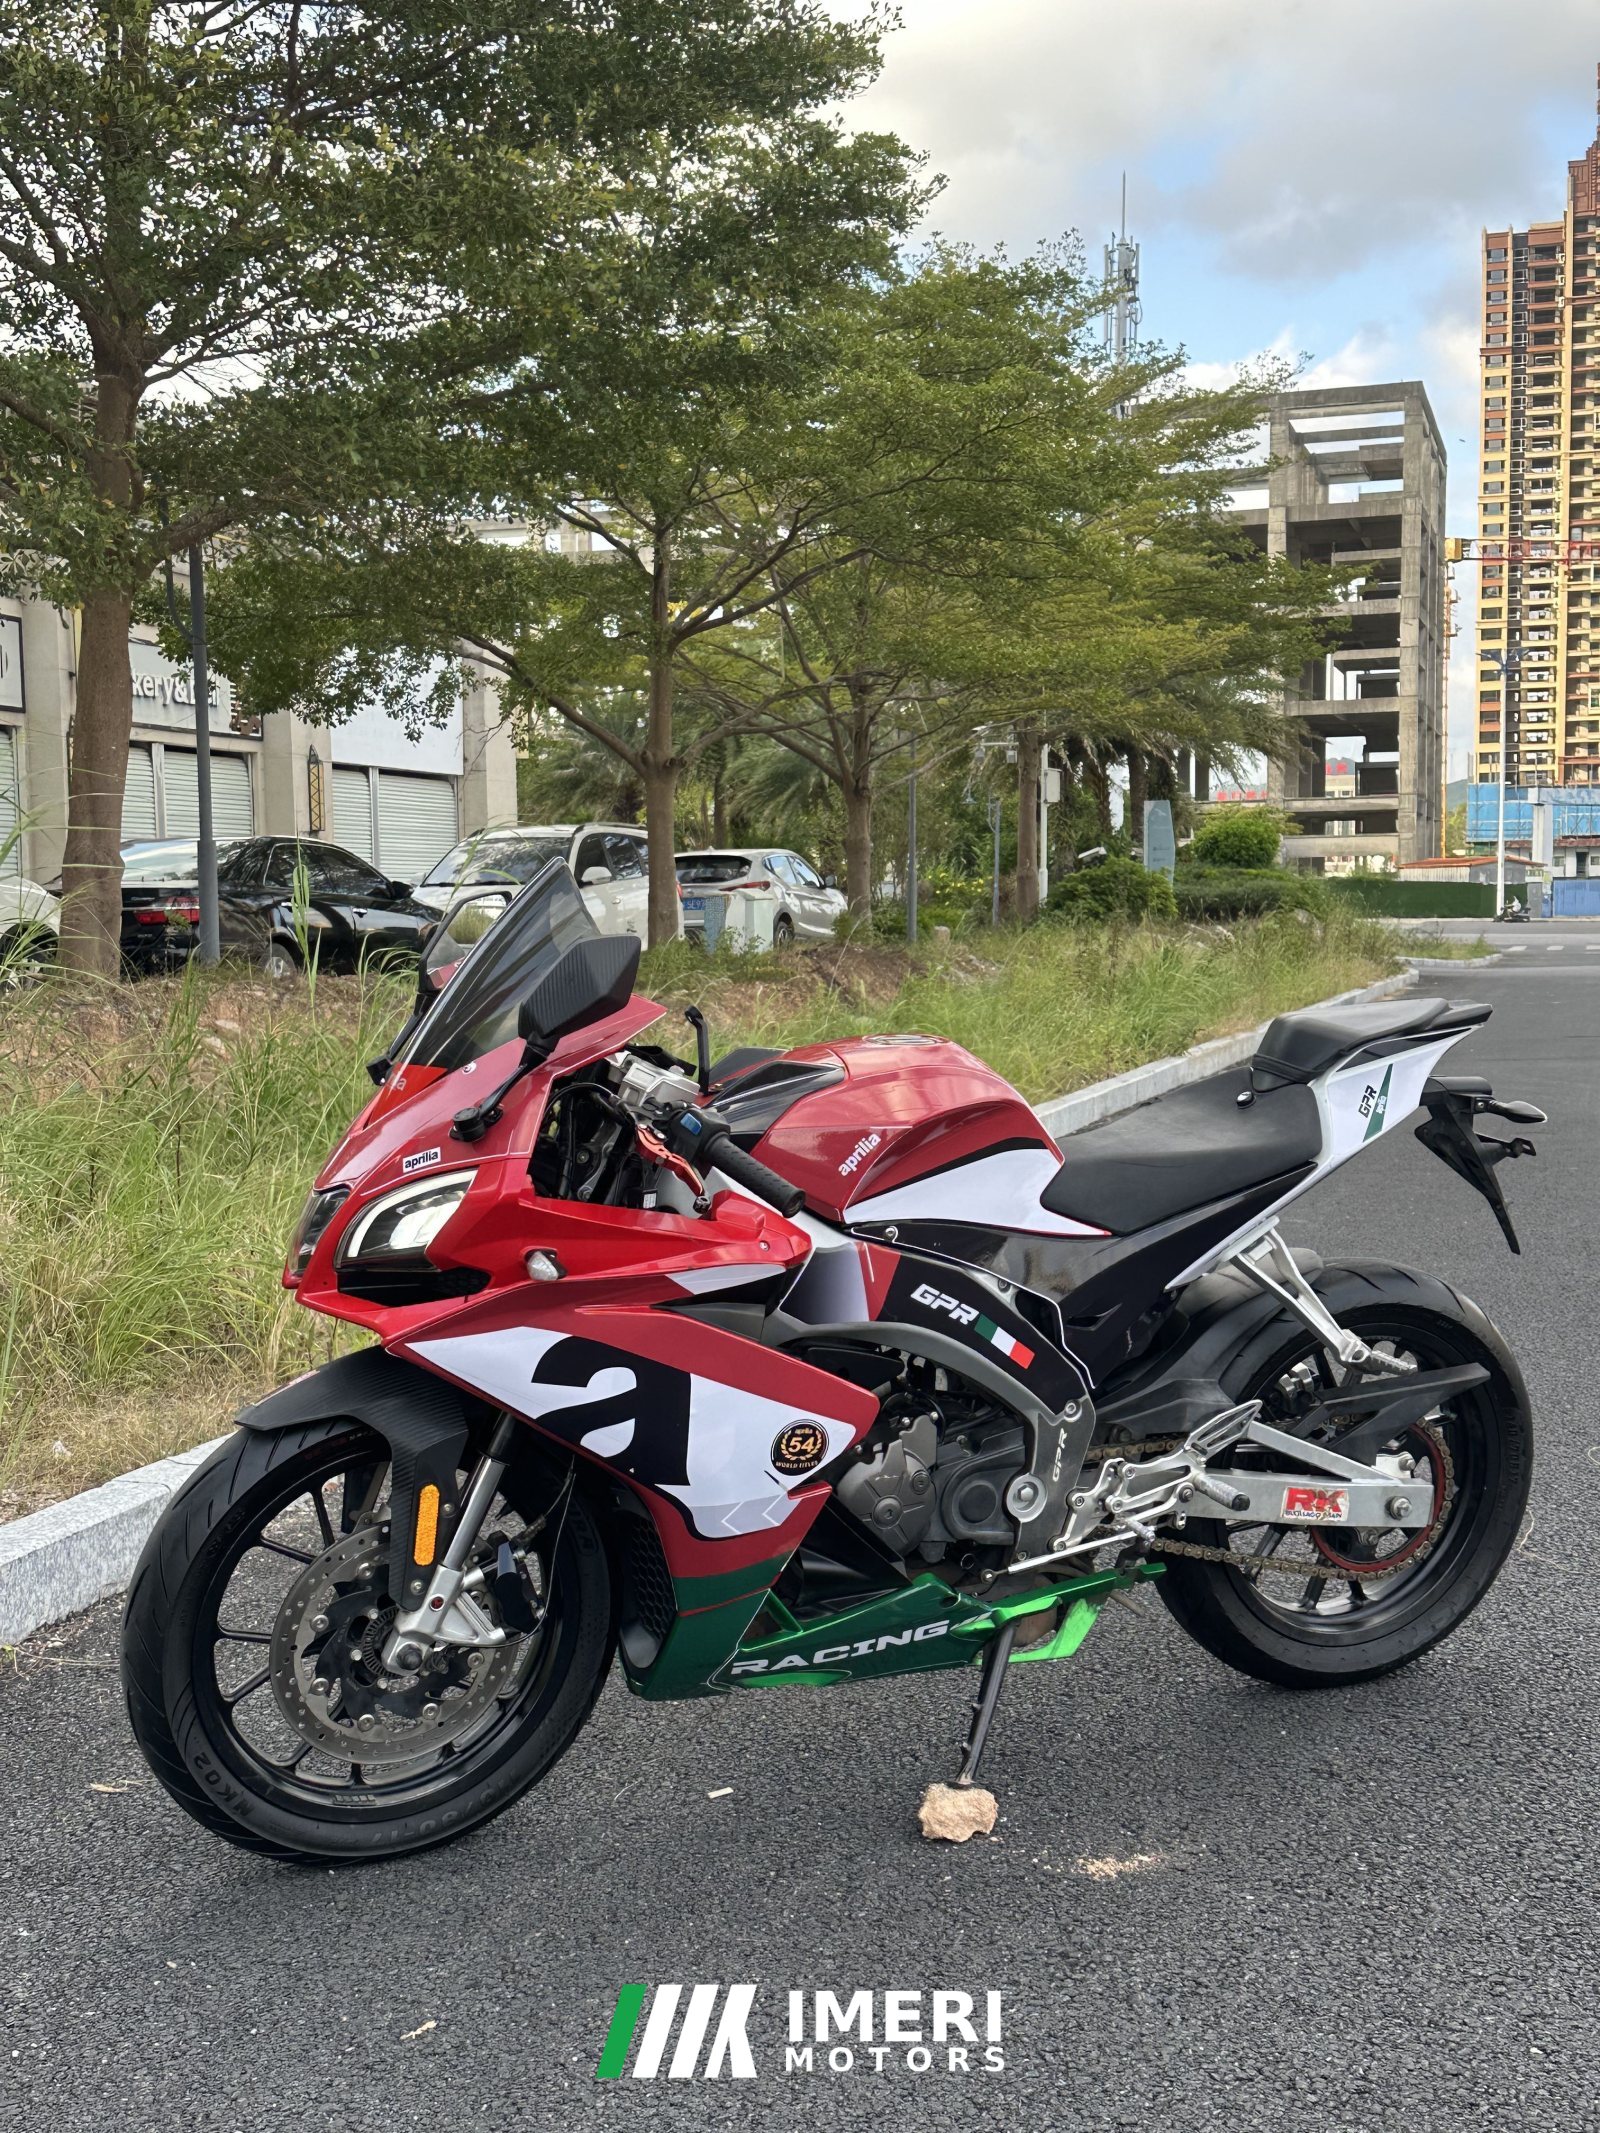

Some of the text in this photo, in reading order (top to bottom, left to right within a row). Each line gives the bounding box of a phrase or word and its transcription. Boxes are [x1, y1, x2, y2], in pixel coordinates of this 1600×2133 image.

[1358, 1084, 1377, 1118] GPR
[404, 1150, 439, 1169] aprilia
[838, 1133, 882, 1177] aprilia
[910, 1283, 980, 1325] GPR
[788, 1437, 815, 1453] 54
[1052, 1427, 1068, 1482] GPR
[775, 1461, 798, 1469] WORLD
[1285, 1486, 1345, 1513] RK
[730, 1620, 950, 1675] RACING
